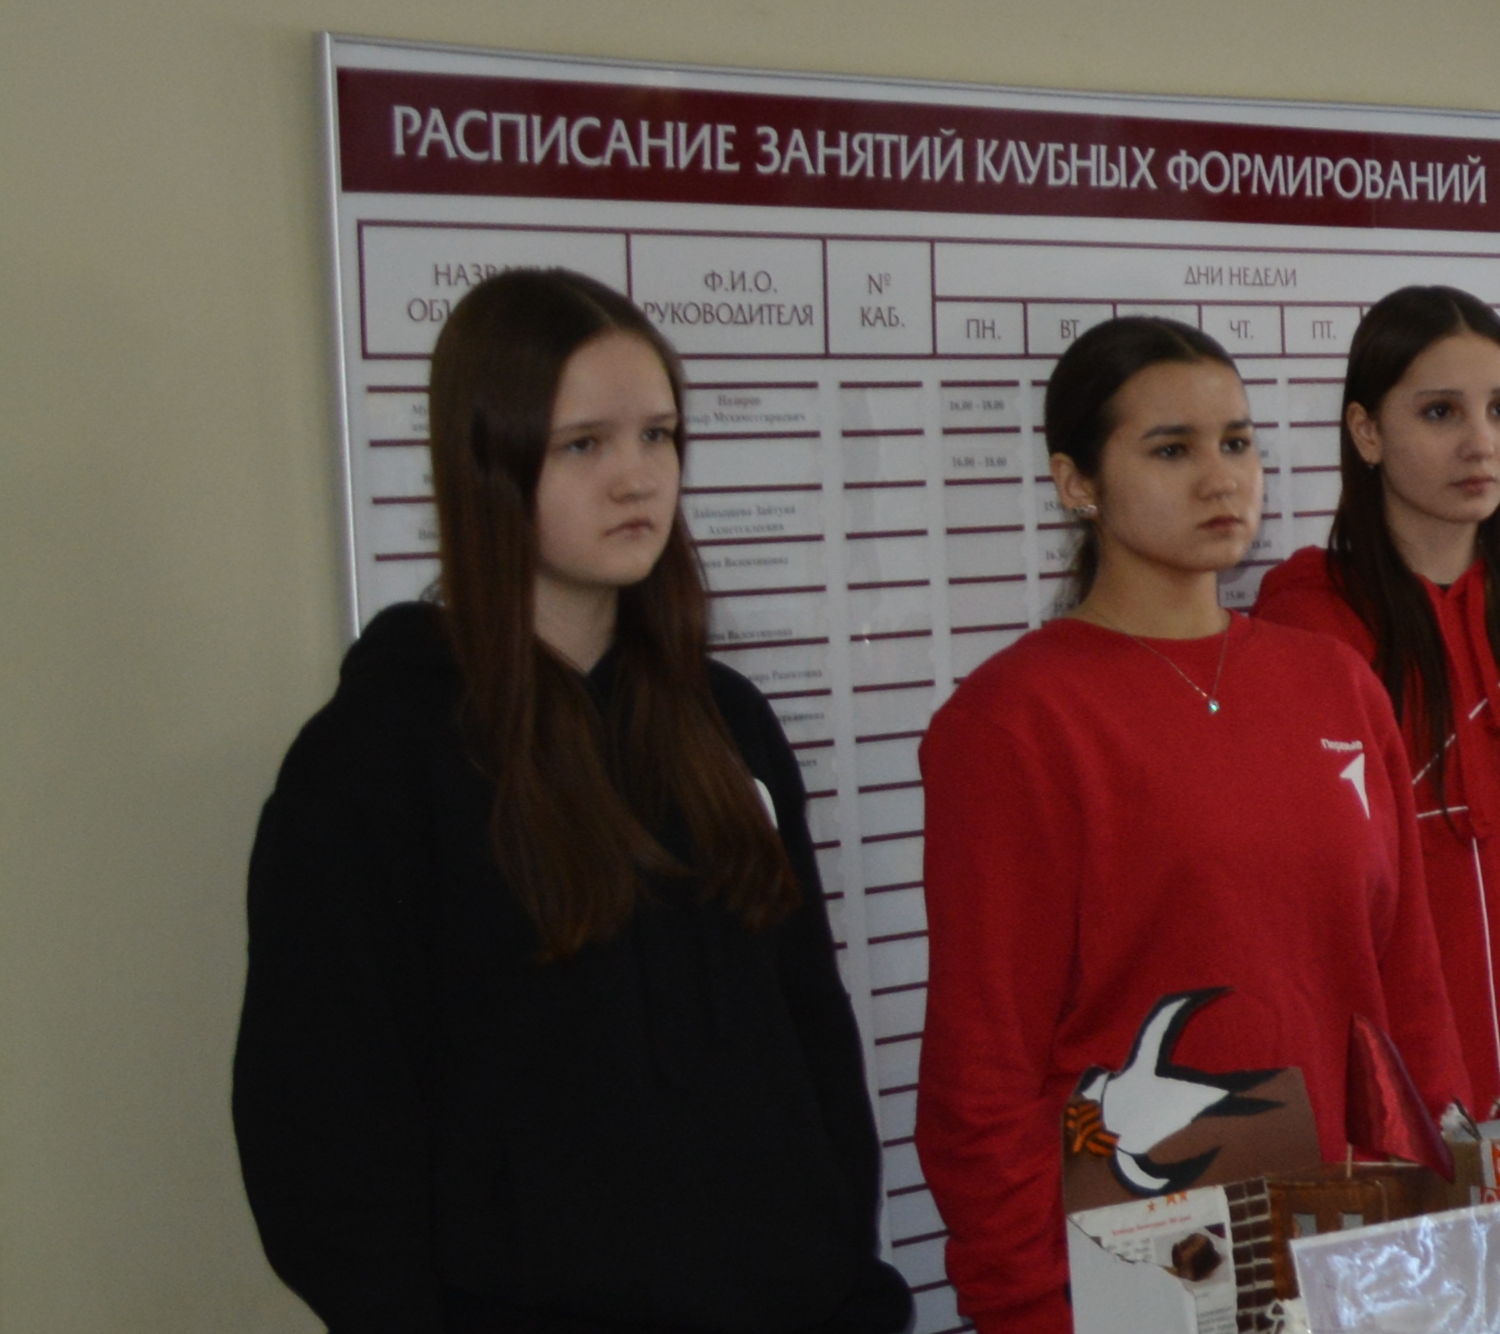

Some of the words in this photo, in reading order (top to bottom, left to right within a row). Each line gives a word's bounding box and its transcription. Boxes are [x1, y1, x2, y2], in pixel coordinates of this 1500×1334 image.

[391, 104, 742, 173] РАСПИСАНИЕ
[755, 124, 964, 182] ЗАНЯТИЙ
[976, 139, 1158, 190] КЛУБНЫХ
[1166, 147, 1487, 205] ФОРМИРОВАНИЙ
[704, 269, 778, 294] Ф.И.О.
[866, 272, 893, 295] №
[1184, 265, 1223, 286] ДНИ
[1229, 267, 1298, 288] НЕДЕЛИ
[643, 300, 814, 326] РУКОВОДИТЕЛЯ
[860, 306, 906, 328] КАБ.
[965, 318, 1002, 340] ПН.
[1229, 320, 1254, 340] ЧТ.
[1311, 320, 1337, 340] ПТ.
